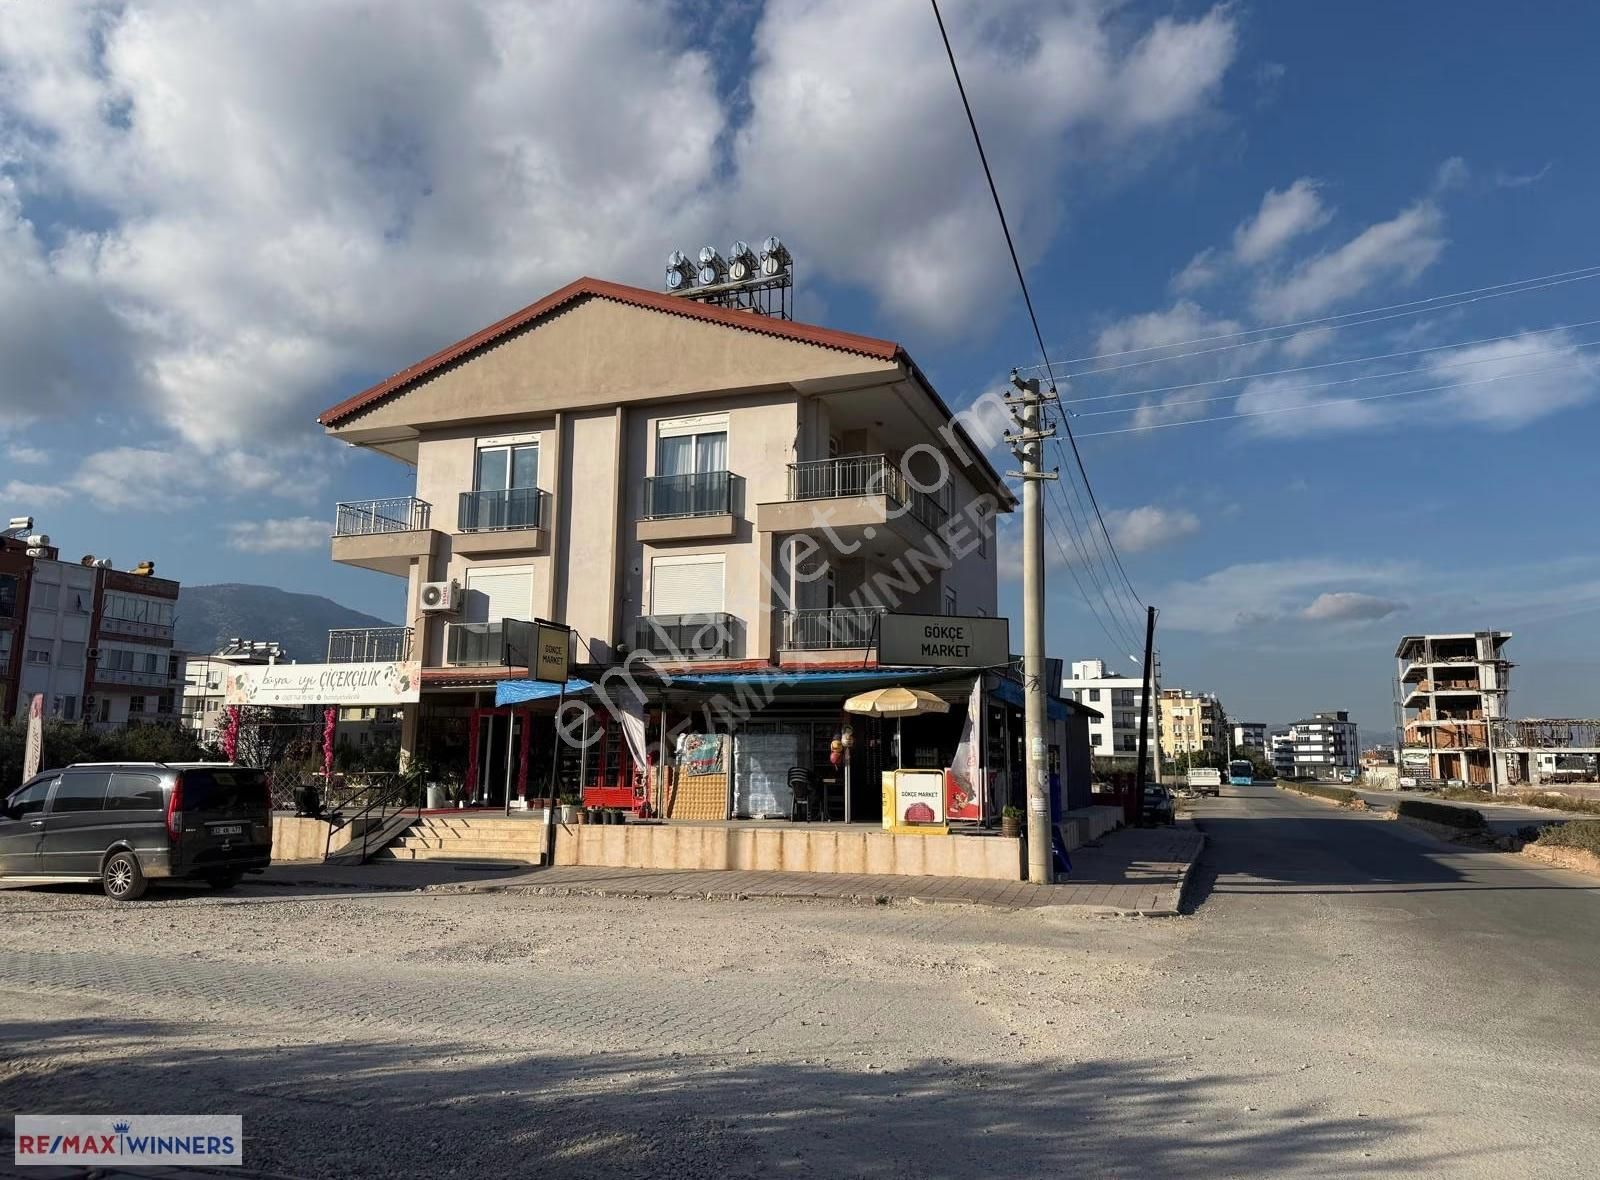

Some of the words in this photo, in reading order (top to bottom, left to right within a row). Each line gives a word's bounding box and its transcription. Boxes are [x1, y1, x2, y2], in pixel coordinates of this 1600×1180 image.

[924, 623, 964, 642] GÖKÇE
[921, 643, 970, 657] MARKET
[542, 655, 563, 666] MARKET
[319, 667, 382, 691] ÇİÇEKÇİLİK
